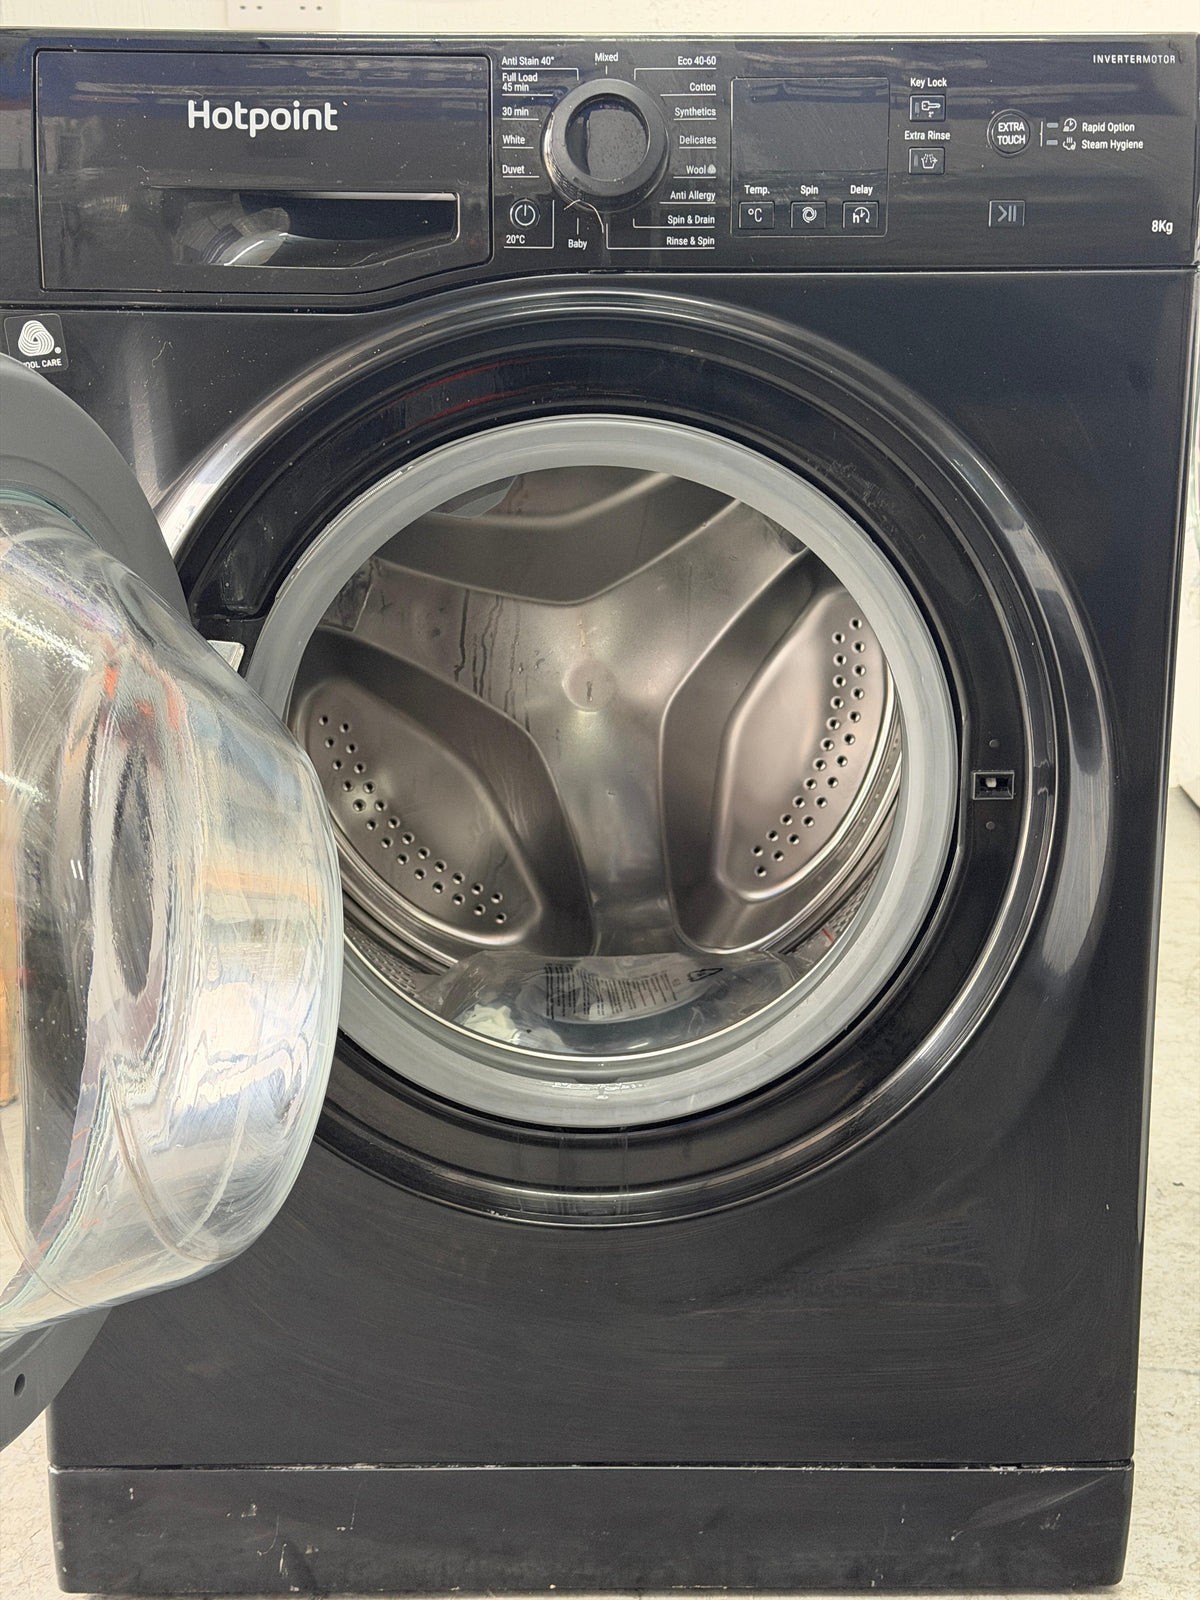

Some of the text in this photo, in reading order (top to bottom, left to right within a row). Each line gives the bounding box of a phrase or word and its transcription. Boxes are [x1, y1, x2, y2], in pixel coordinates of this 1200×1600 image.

[501, 56, 518, 66] Anti
[519, 56, 540, 66] Stain
[594, 52, 619, 62] Mixed
[677, 56, 717, 66] Eco 40-60
[1092, 54, 1176, 65] INVERTERMOTOR
[502, 72, 538, 82] Full Load
[502, 83, 529, 92] 45 min
[689, 82, 717, 92] Cotton
[910, 77, 948, 89] Key Lock
[502, 107, 529, 116] 30 min
[674, 107, 717, 118] Synthetics
[187, 100, 338, 138] Hotpoint
[997, 121, 1025, 133] EXTRA
[1081, 122, 1136, 134] Rapid Option
[502, 135, 526, 145] White
[679, 135, 717, 145] Delicates
[904, 130, 951, 141] Extra Rinse
[997, 135, 1026, 145] TOUCH
[1081, 139, 1144, 151] Steam Hygiene
[502, 165, 525, 174] Duvet
[686, 165, 707, 174] Wool
[744, 184, 771, 196] Temp.
[800, 184, 819, 196] Spin
[850, 184, 874, 196] Delay
[670, 190, 716, 202] Anti Allergy
[667, 215, 715, 226] Spin & Drain
[1151, 219, 1173, 235] 8Kg
[505, 234, 526, 244] 20°C
[568, 239, 588, 250] Baby
[666, 236, 715, 248] Rinse & Spin
[22, 358, 63, 369] OOL CARE
